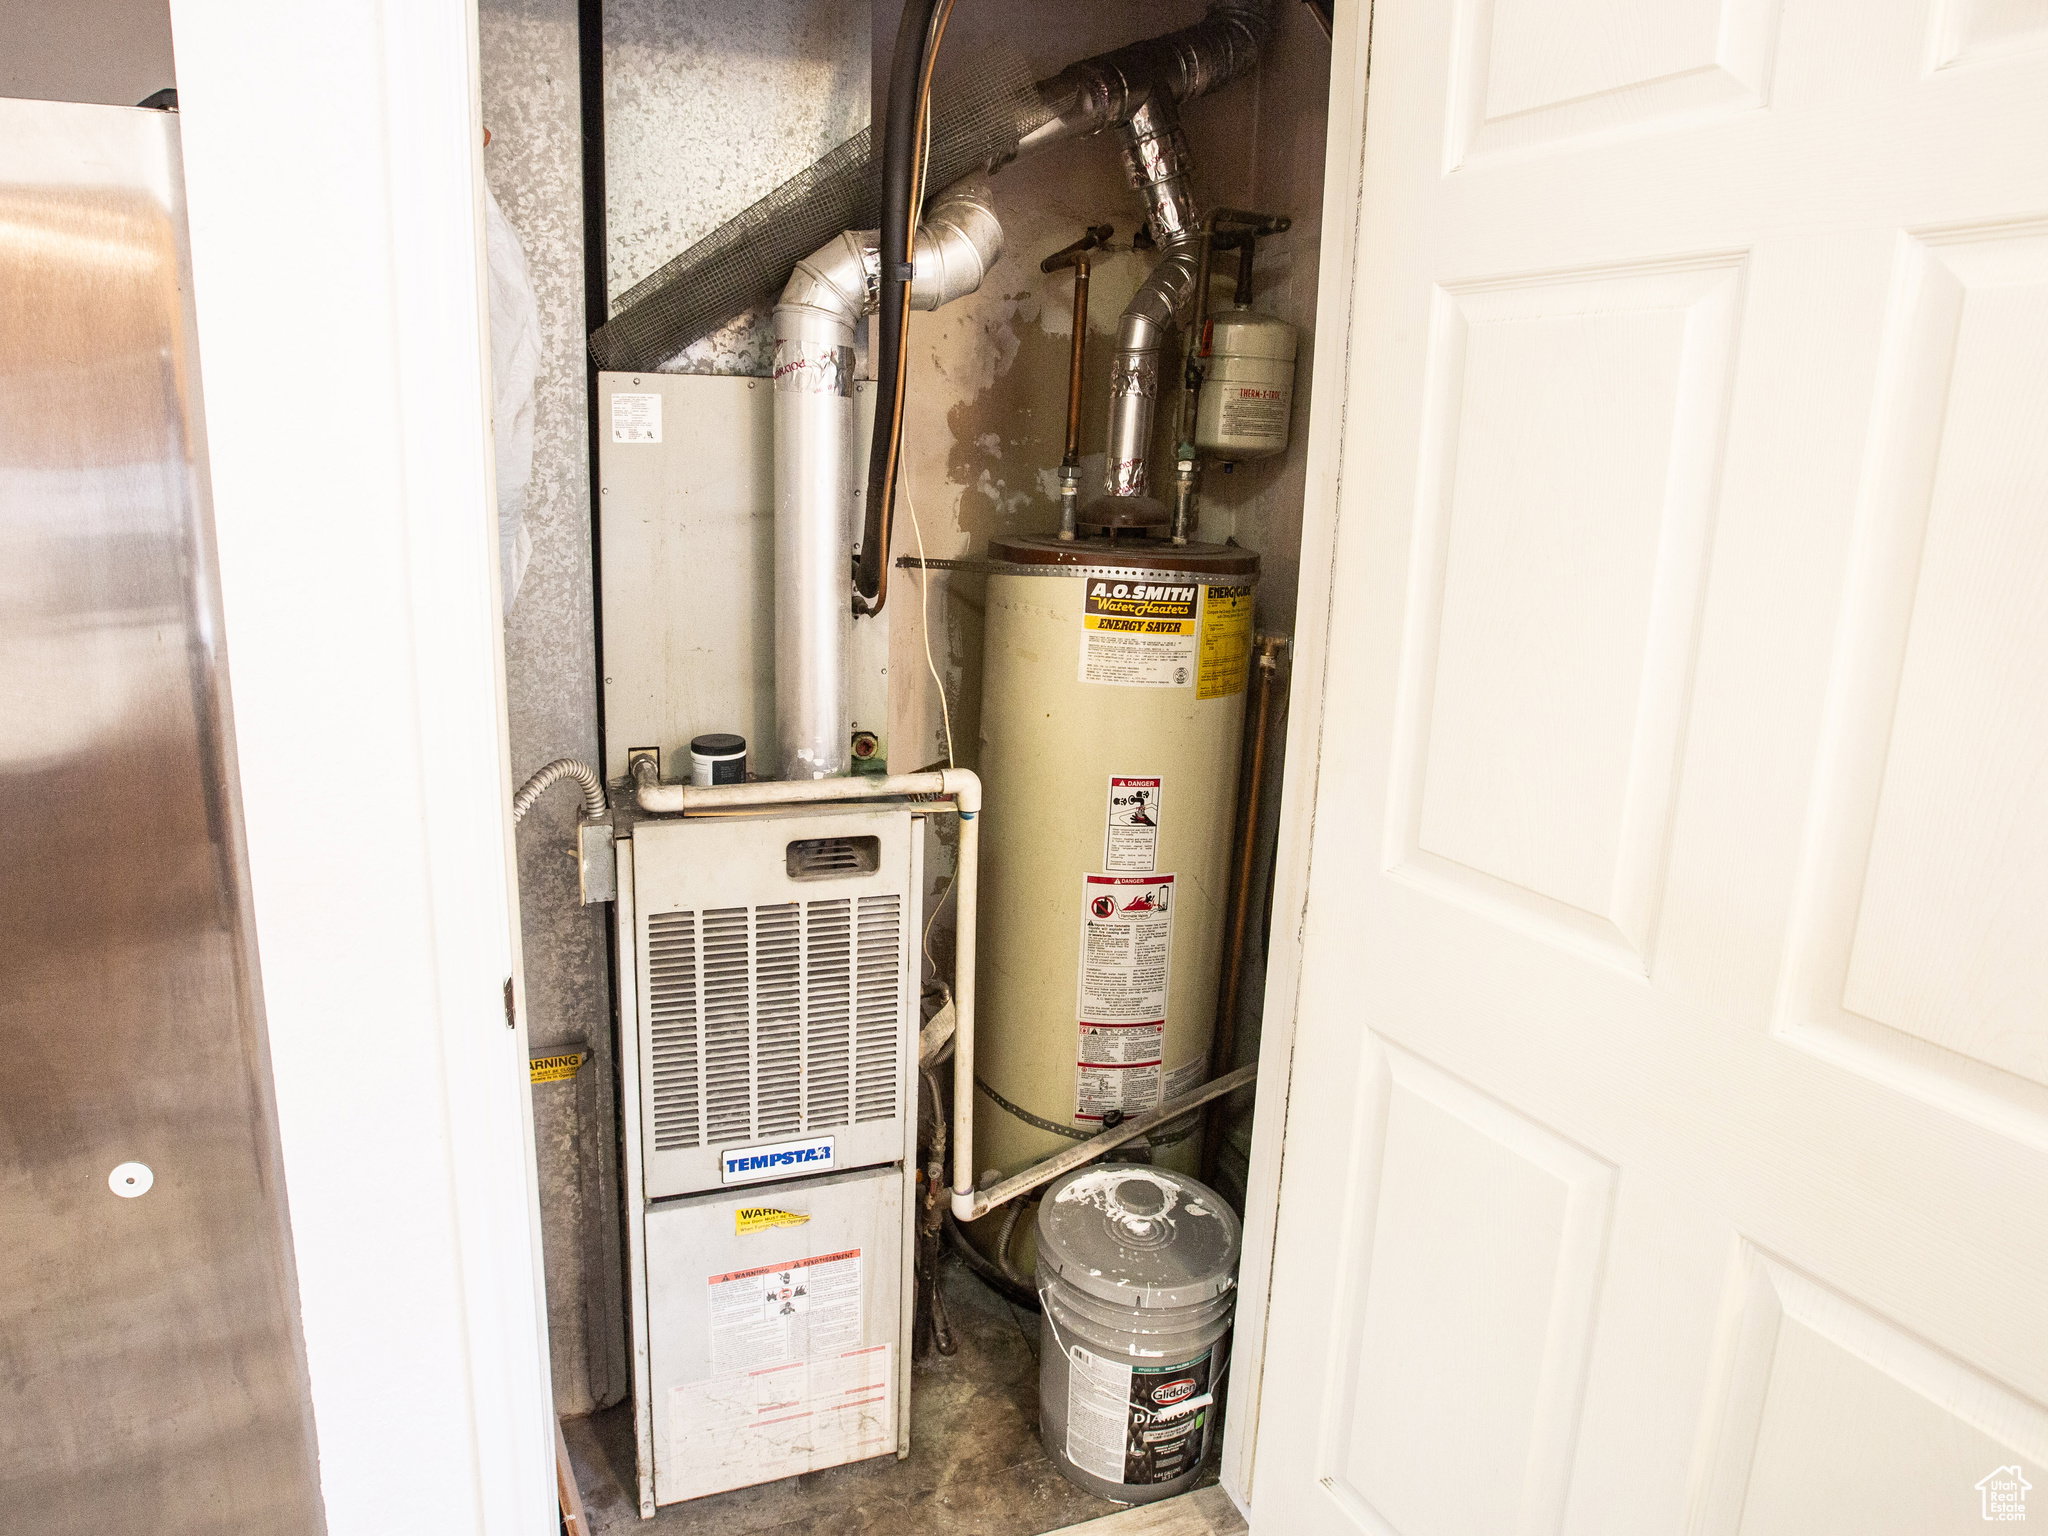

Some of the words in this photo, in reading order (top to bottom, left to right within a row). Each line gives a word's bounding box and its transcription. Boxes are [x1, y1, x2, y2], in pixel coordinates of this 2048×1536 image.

[1098, 619, 1146, 632] ENERGY
[1146, 622, 1182, 633] SAVER
[530, 1055, 578, 1070] ARNING
[727, 1146, 832, 1173] TEMPSTAR
[741, 1208, 786, 1219] WARN
[1153, 1384, 1196, 1400] Glidden
